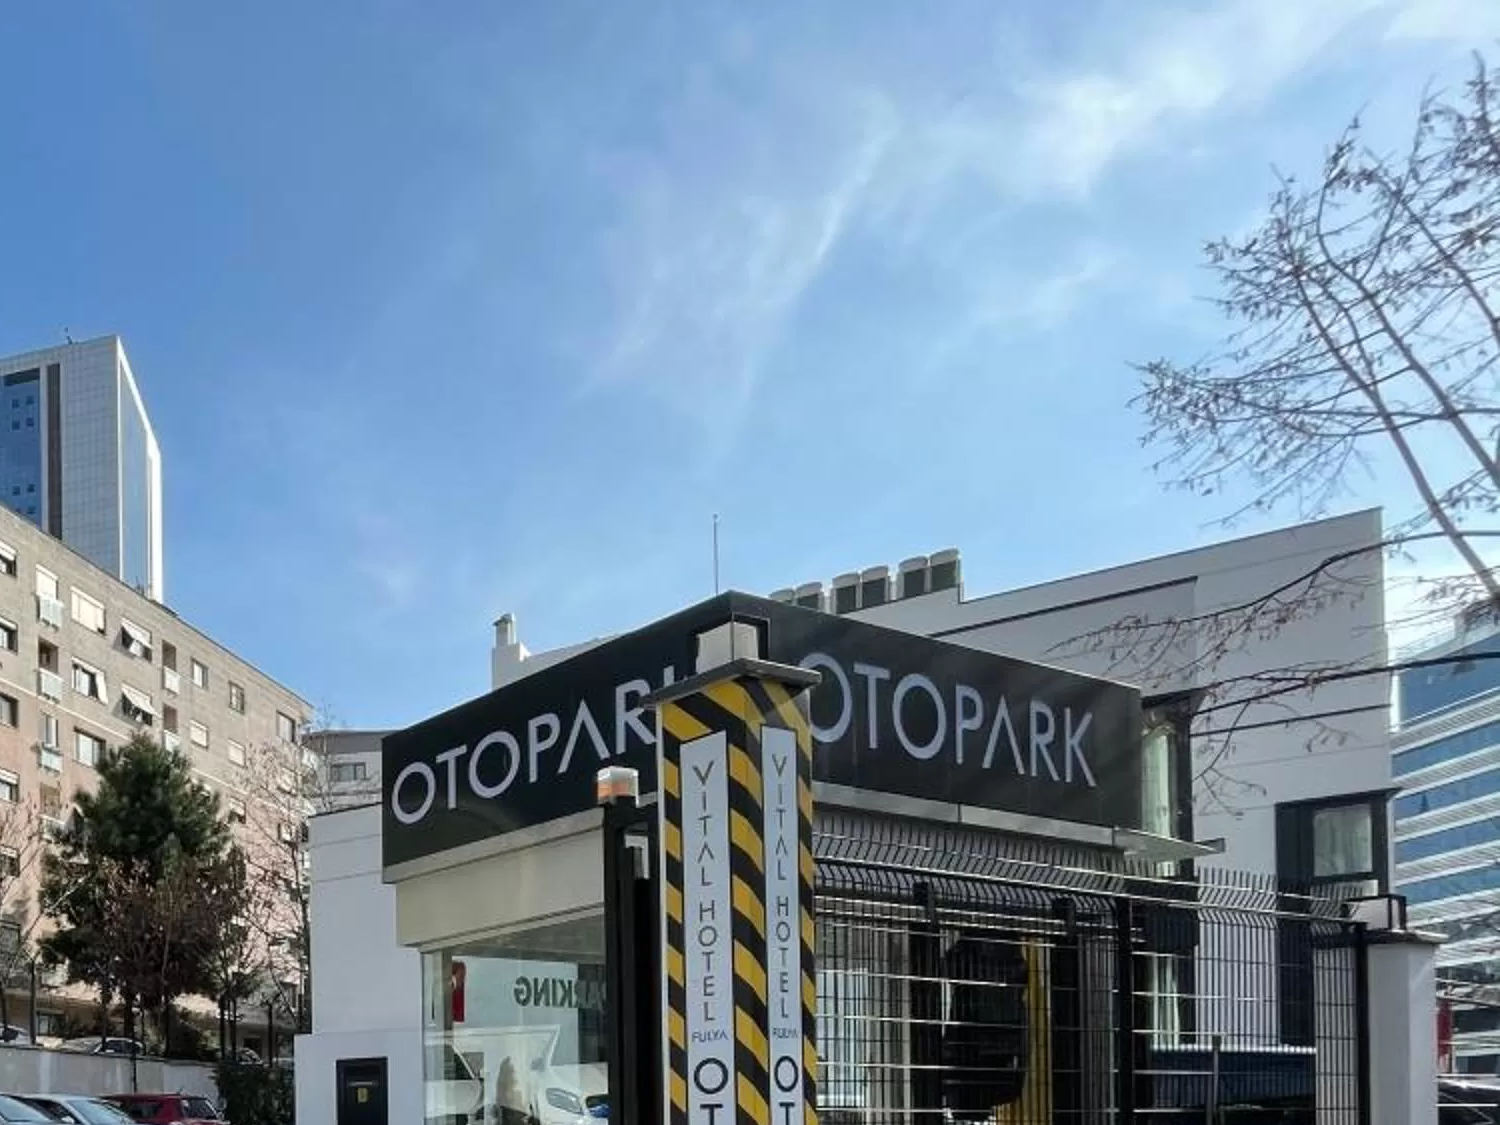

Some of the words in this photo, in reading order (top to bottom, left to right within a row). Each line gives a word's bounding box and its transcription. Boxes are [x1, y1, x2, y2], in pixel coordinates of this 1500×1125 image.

[392, 665, 688, 825] OTOPAR
[802, 651, 1098, 788] OTOPARK
[692, 759, 715, 887] VITAL
[772, 753, 788, 882] VITAL
[697, 899, 718, 1022] HOTEL
[775, 895, 790, 1019] HOTEL
[692, 1029, 729, 1043] FULYA
